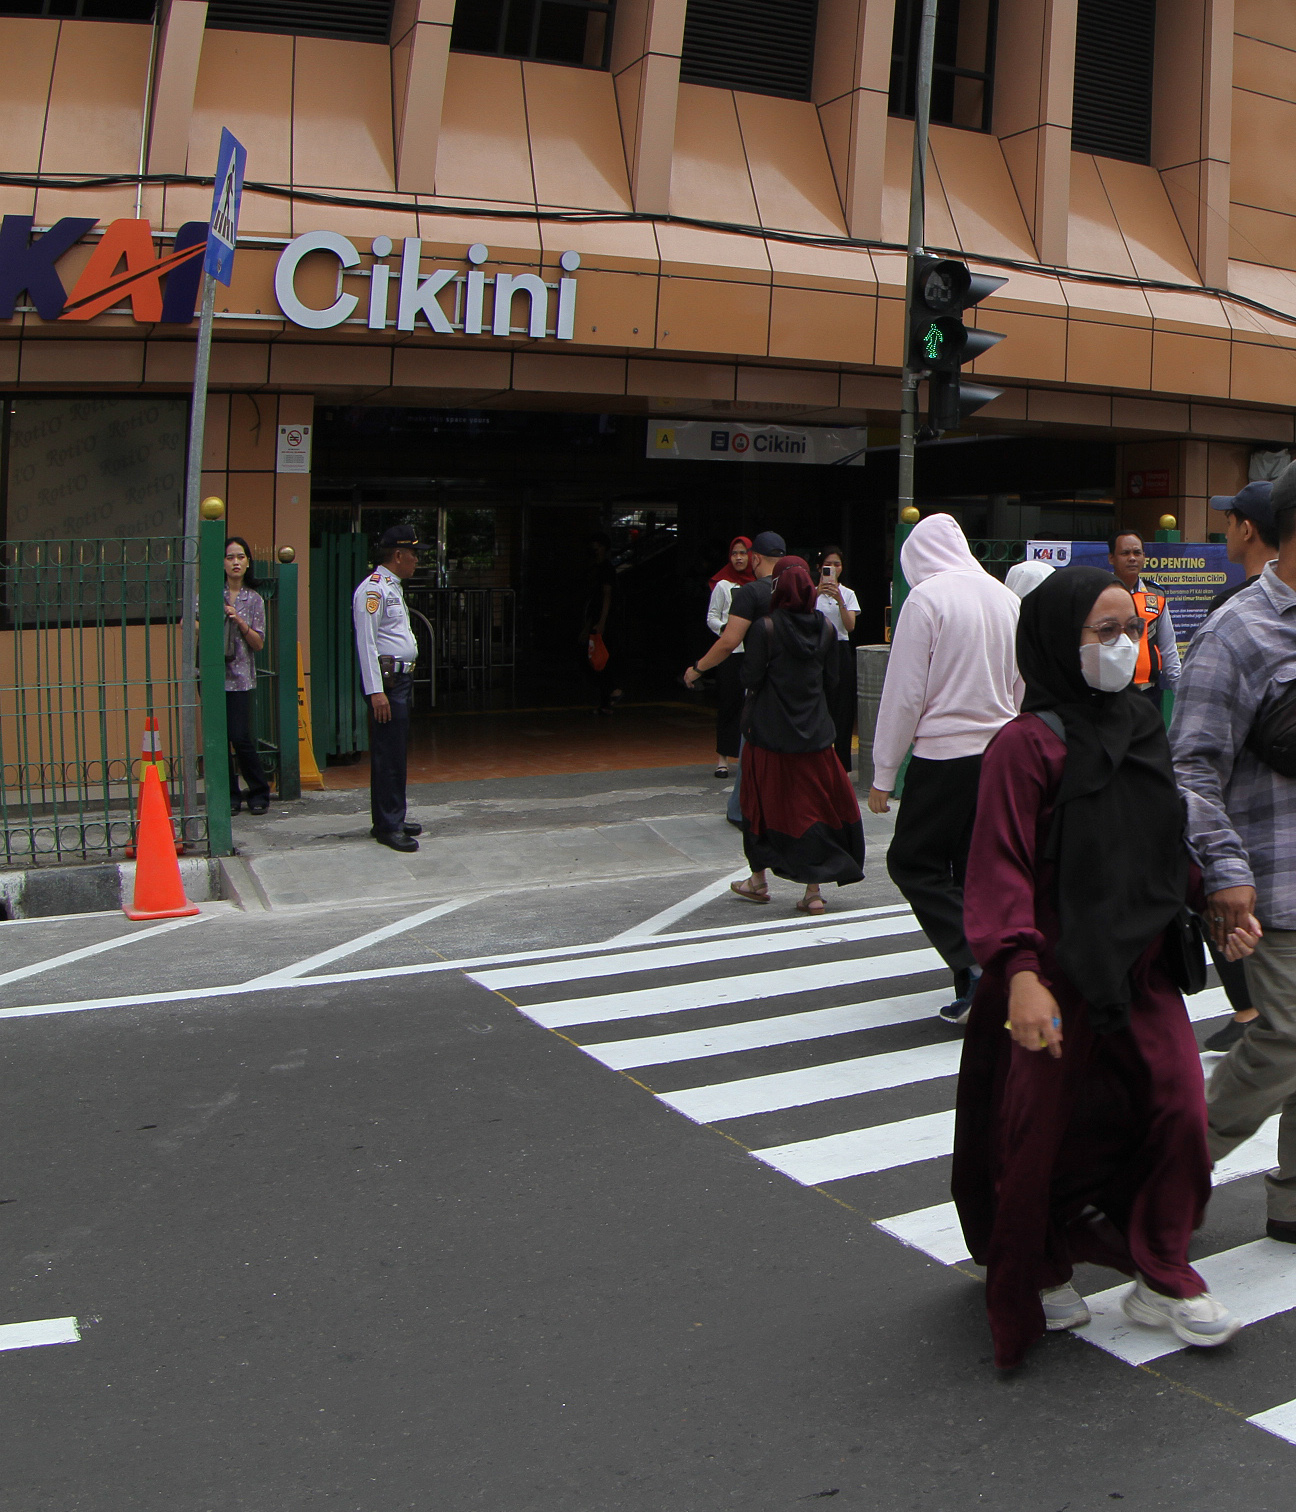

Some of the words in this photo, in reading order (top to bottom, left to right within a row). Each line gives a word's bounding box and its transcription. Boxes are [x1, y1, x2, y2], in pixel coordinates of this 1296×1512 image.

[0, 214, 208, 322] KAI
[274, 230, 580, 340] Cikini
[661, 434, 669, 443] A
[753, 434, 807, 454] Cikini
[1033, 548, 1053, 560] KAI
[1160, 557, 1206, 569] PENTING
[1181, 574, 1205, 583] Stasiun
[1206, 574, 1225, 583] Cikini
